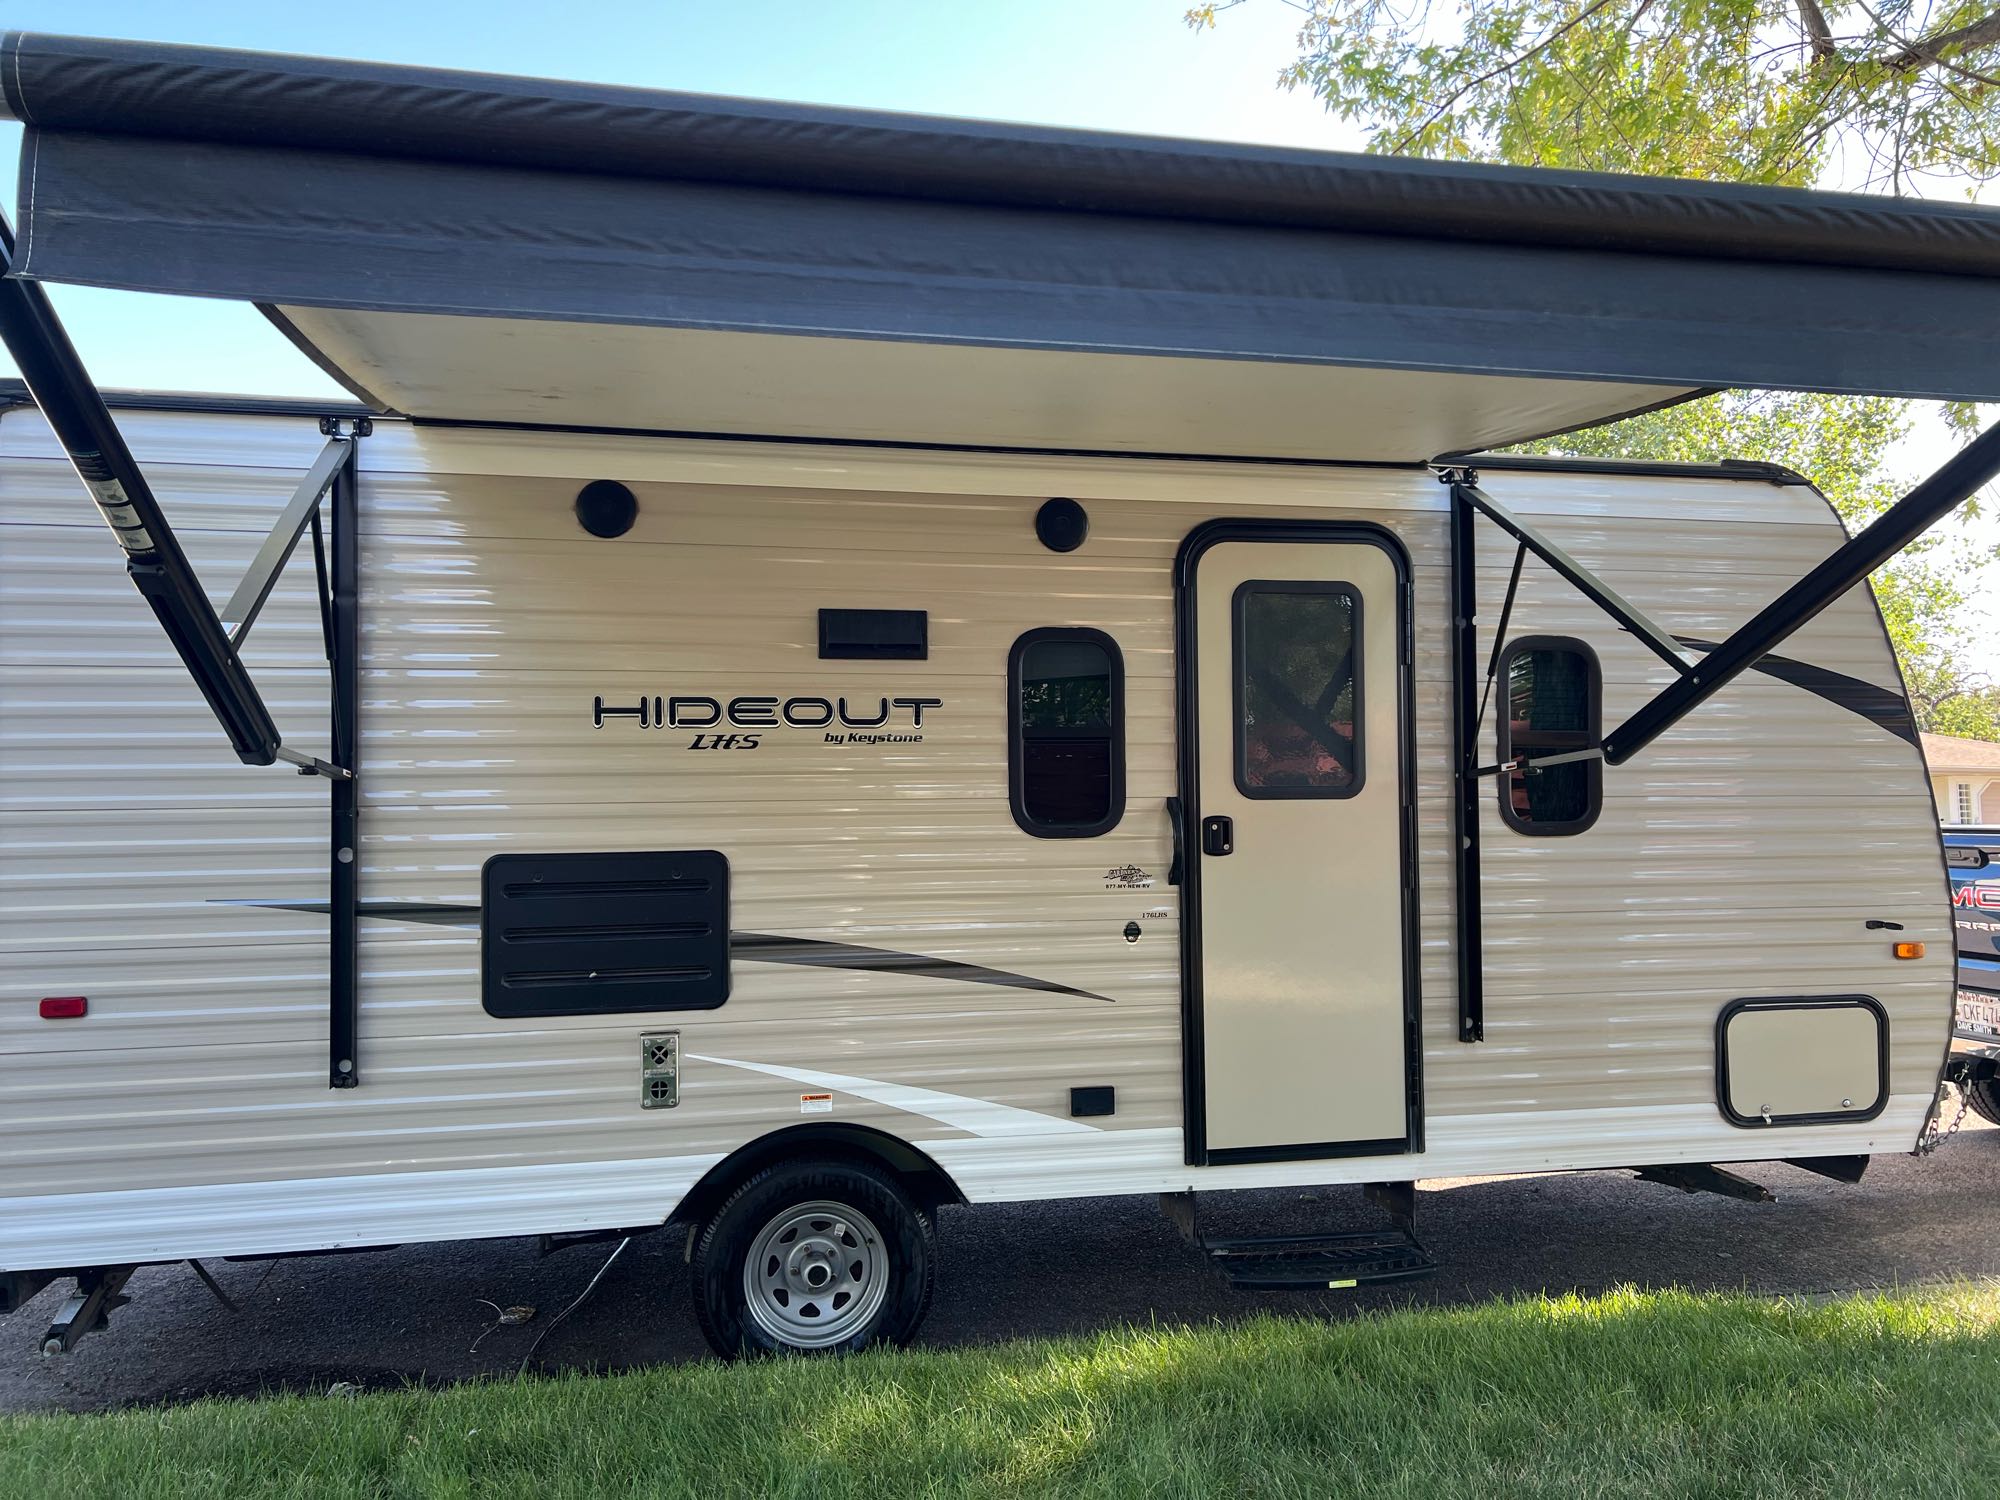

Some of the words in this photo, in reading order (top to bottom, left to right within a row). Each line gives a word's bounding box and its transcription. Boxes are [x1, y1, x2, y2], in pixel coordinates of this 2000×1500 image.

[592, 695, 944, 729] HIDEOUT
[687, 734, 763, 750] LHS
[824, 732, 845, 745] by
[847, 732, 924, 744] Keystone
[1957, 1020, 1973, 1032] DAVE
[1973, 1023, 1993, 1035] SMITH
